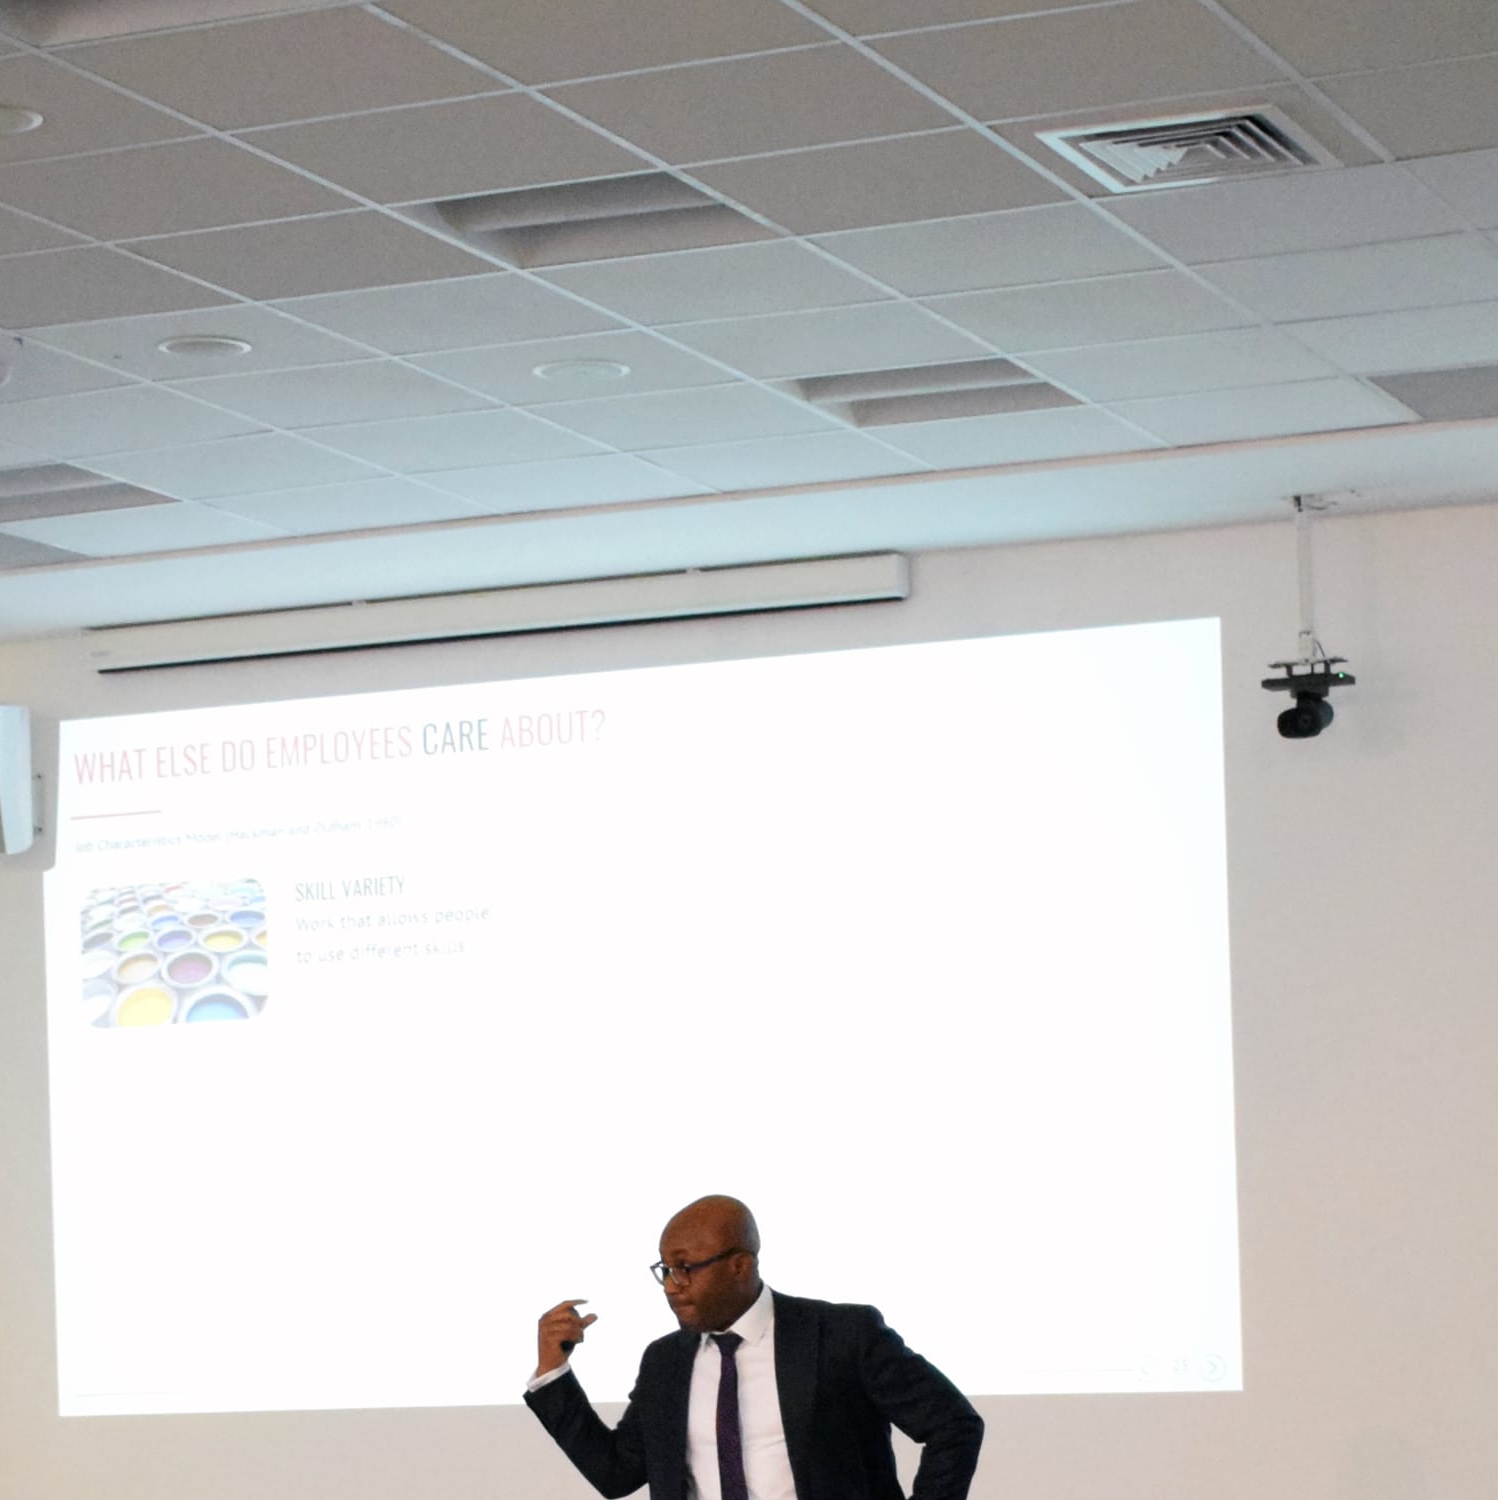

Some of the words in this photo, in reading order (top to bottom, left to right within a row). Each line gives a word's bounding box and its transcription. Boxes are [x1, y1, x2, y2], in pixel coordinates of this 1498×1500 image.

[74, 748, 146, 785] WHAT
[156, 742, 211, 778] ELSE
[221, 739, 255, 773] DO
[266, 726, 412, 768] EMPLOYEES
[421, 718, 490, 756] CARE
[501, 709, 605, 749] ABOUT?
[294, 881, 336, 902] SKILL
[342, 876, 405, 898] VARIETY
[296, 917, 334, 932] Work
[340, 915, 373, 928] that
[377, 913, 428, 928] allows
[435, 907, 489, 924] people
